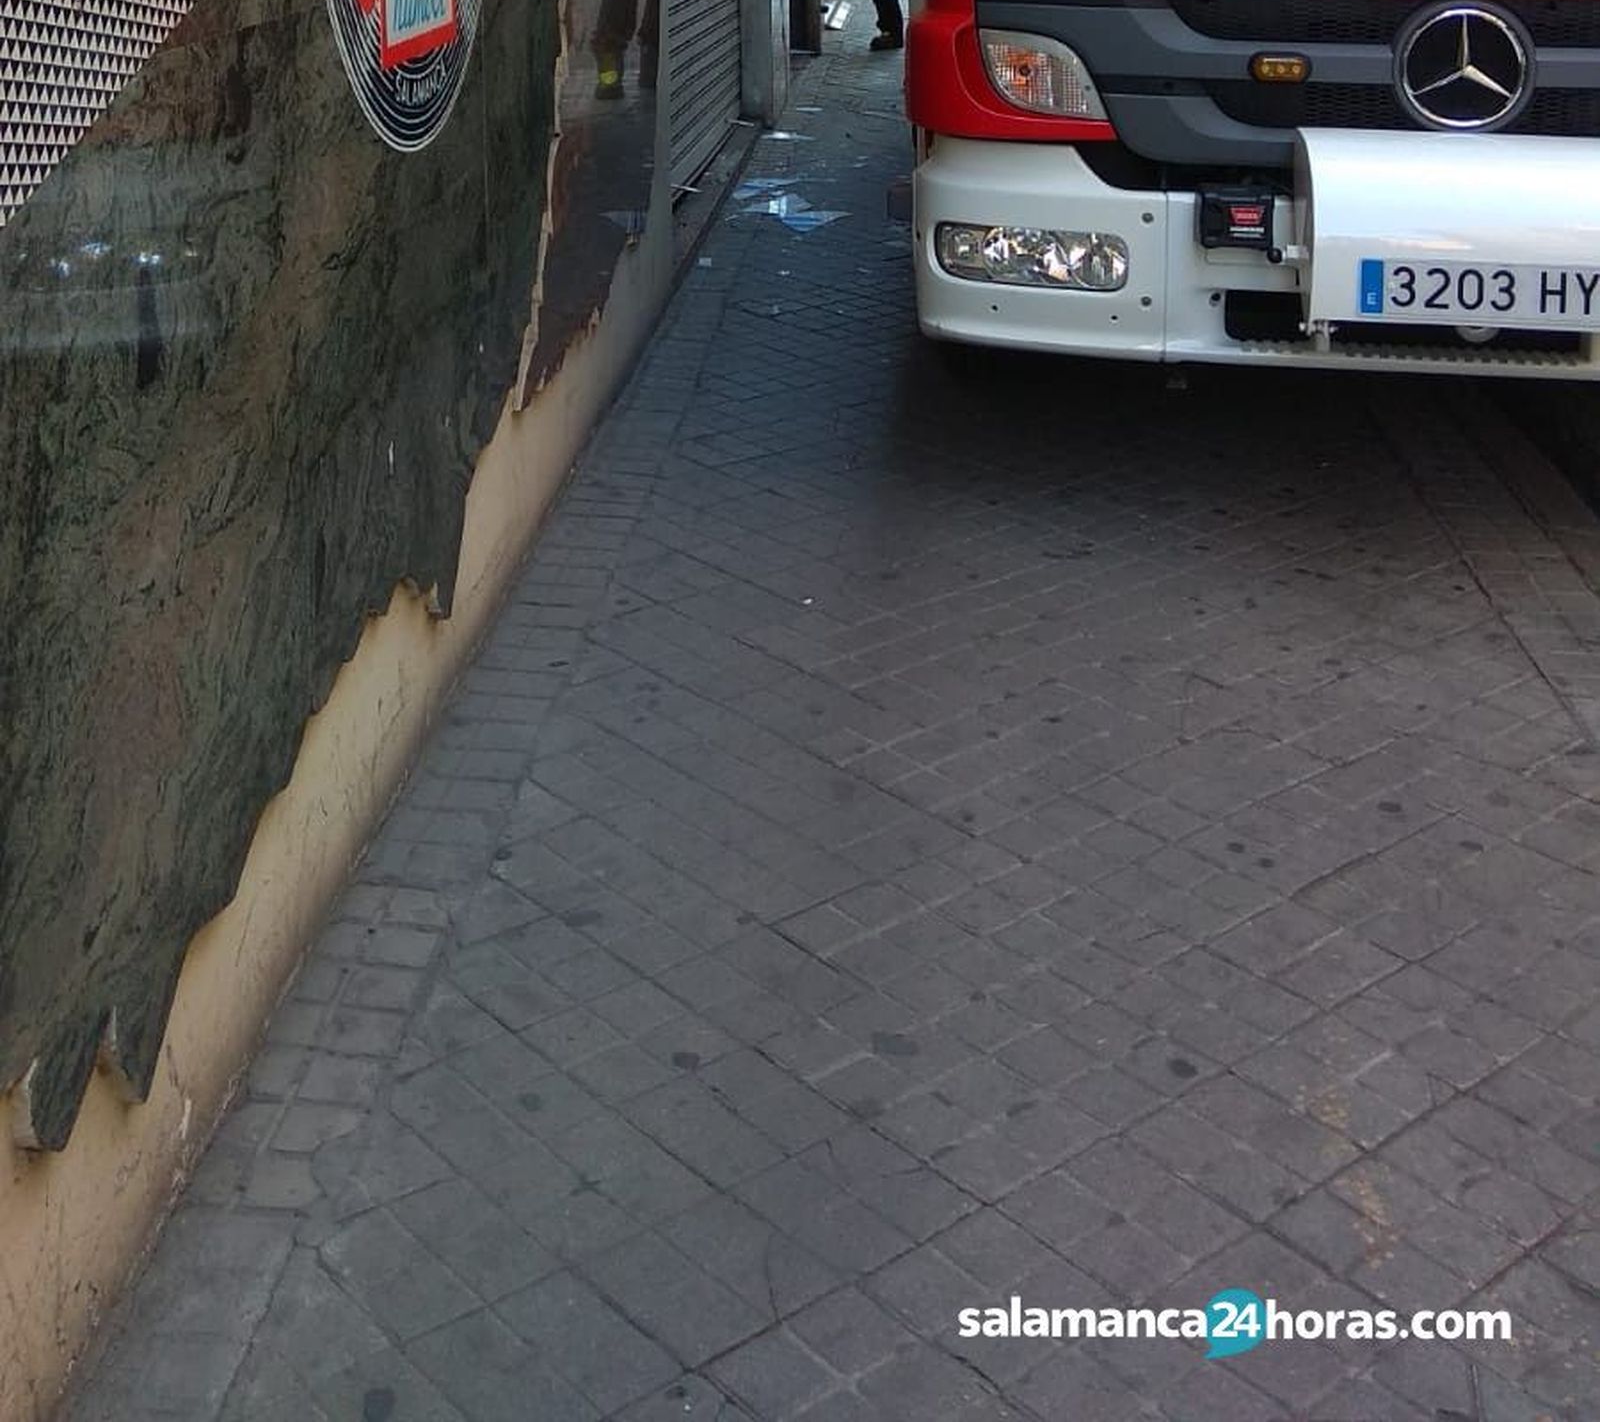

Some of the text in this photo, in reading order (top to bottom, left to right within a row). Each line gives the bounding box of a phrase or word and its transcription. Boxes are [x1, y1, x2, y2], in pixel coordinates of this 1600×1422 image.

[395, 57, 447, 106] SALAMANCA
[1366, 291, 1377, 306] E
[1390, 265, 1517, 312] 3203
